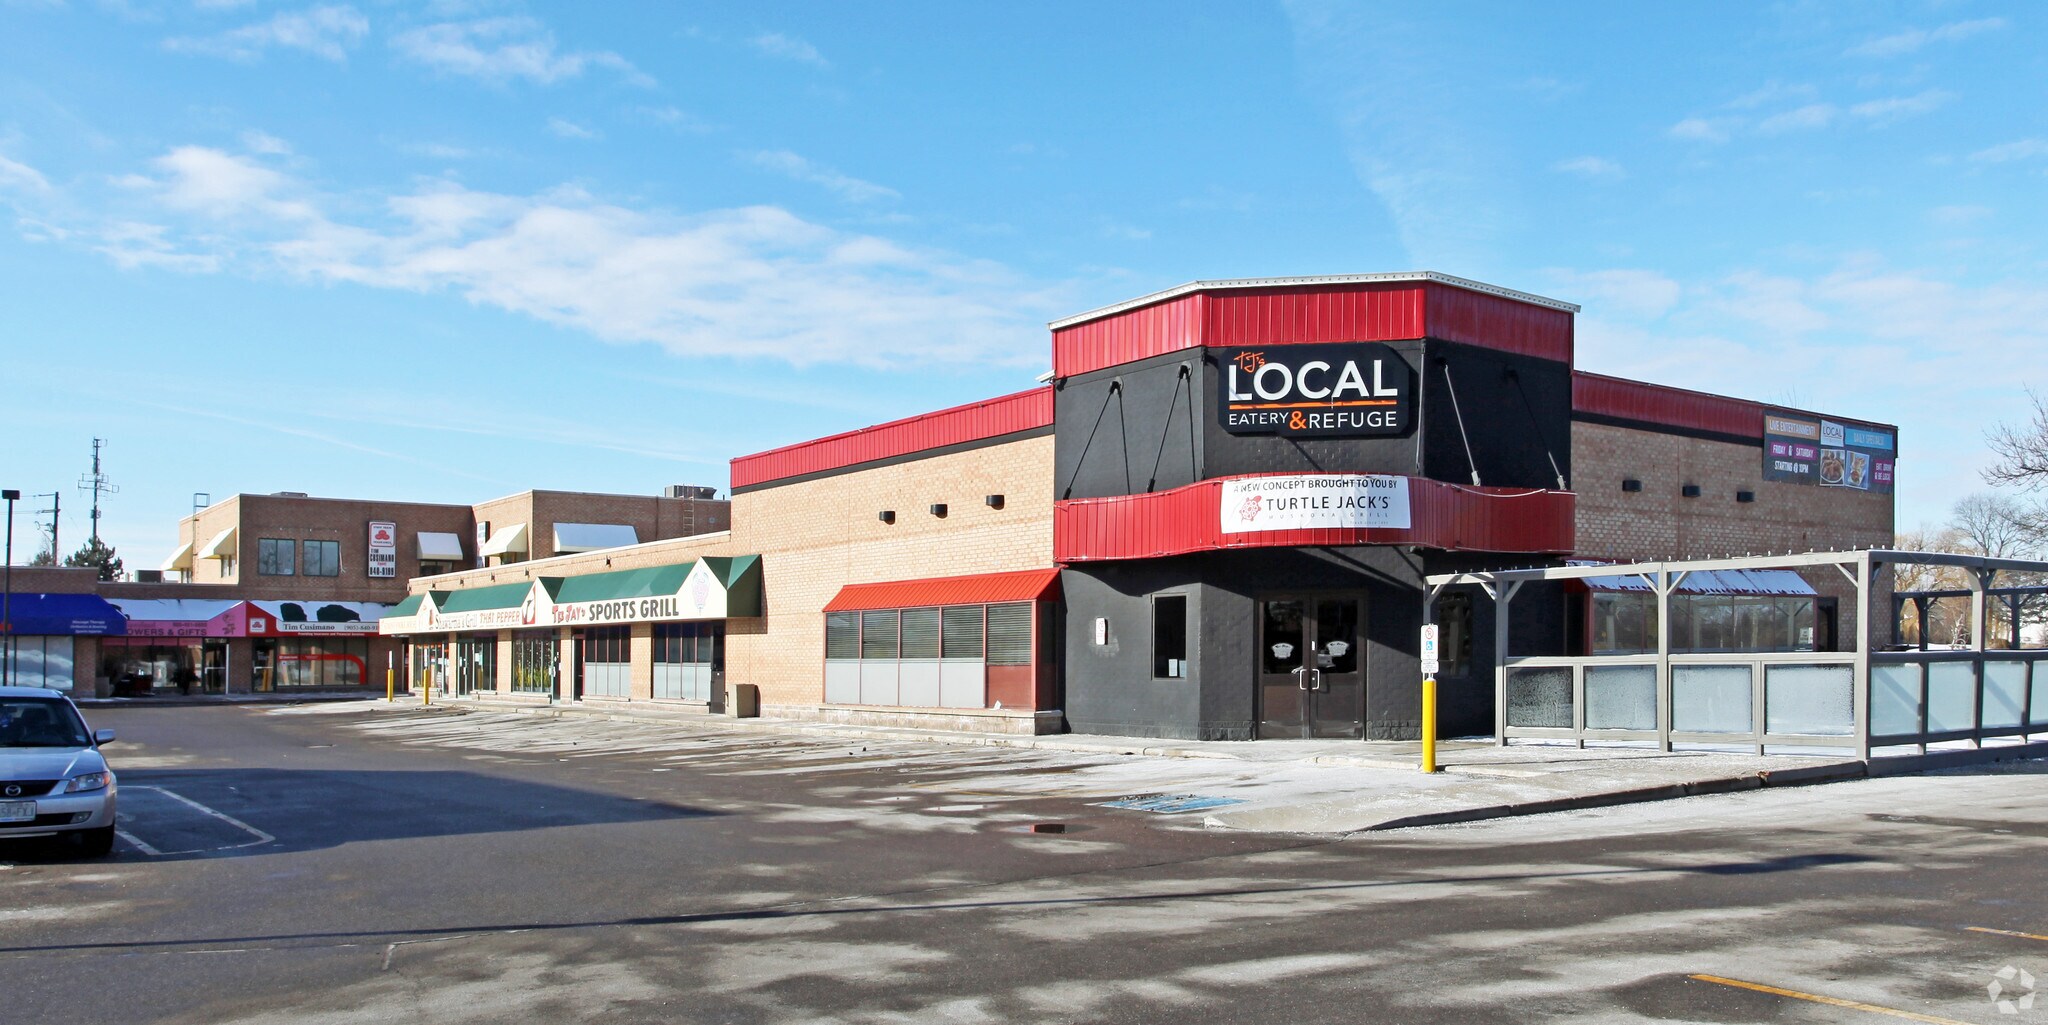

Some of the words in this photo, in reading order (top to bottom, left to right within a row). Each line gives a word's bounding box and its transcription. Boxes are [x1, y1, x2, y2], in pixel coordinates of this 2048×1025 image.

[1228, 359, 1398, 401] LOCAL
[1228, 412, 1289, 426] EATERY
[1289, 411, 1307, 430] &
[1309, 410, 1397, 429] REFUGE
[1823, 427, 1842, 437] LOCAL
[1240, 483, 1260, 493] NEW
[1262, 480, 1305, 491] CONCEPT
[1308, 479, 1355, 489] BROUGHT
[1356, 479, 1369, 488] TO
[1370, 480, 1387, 488] YOU
[1388, 480, 1398, 489] BY
[1266, 496, 1330, 511] TURTLE
[1336, 495, 1390, 510] JACK'S
[589, 600, 636, 621] SPORTS
[640, 597, 679, 618] GRILL
[480, 613, 495, 624] THAI
[497, 611, 520, 623] PEPPER
[127, 628, 164, 636] OWERS
[178, 628, 207, 636] GIFTS
[284, 623, 298, 631] Tim
[300, 623, 335, 631] Cusimano
